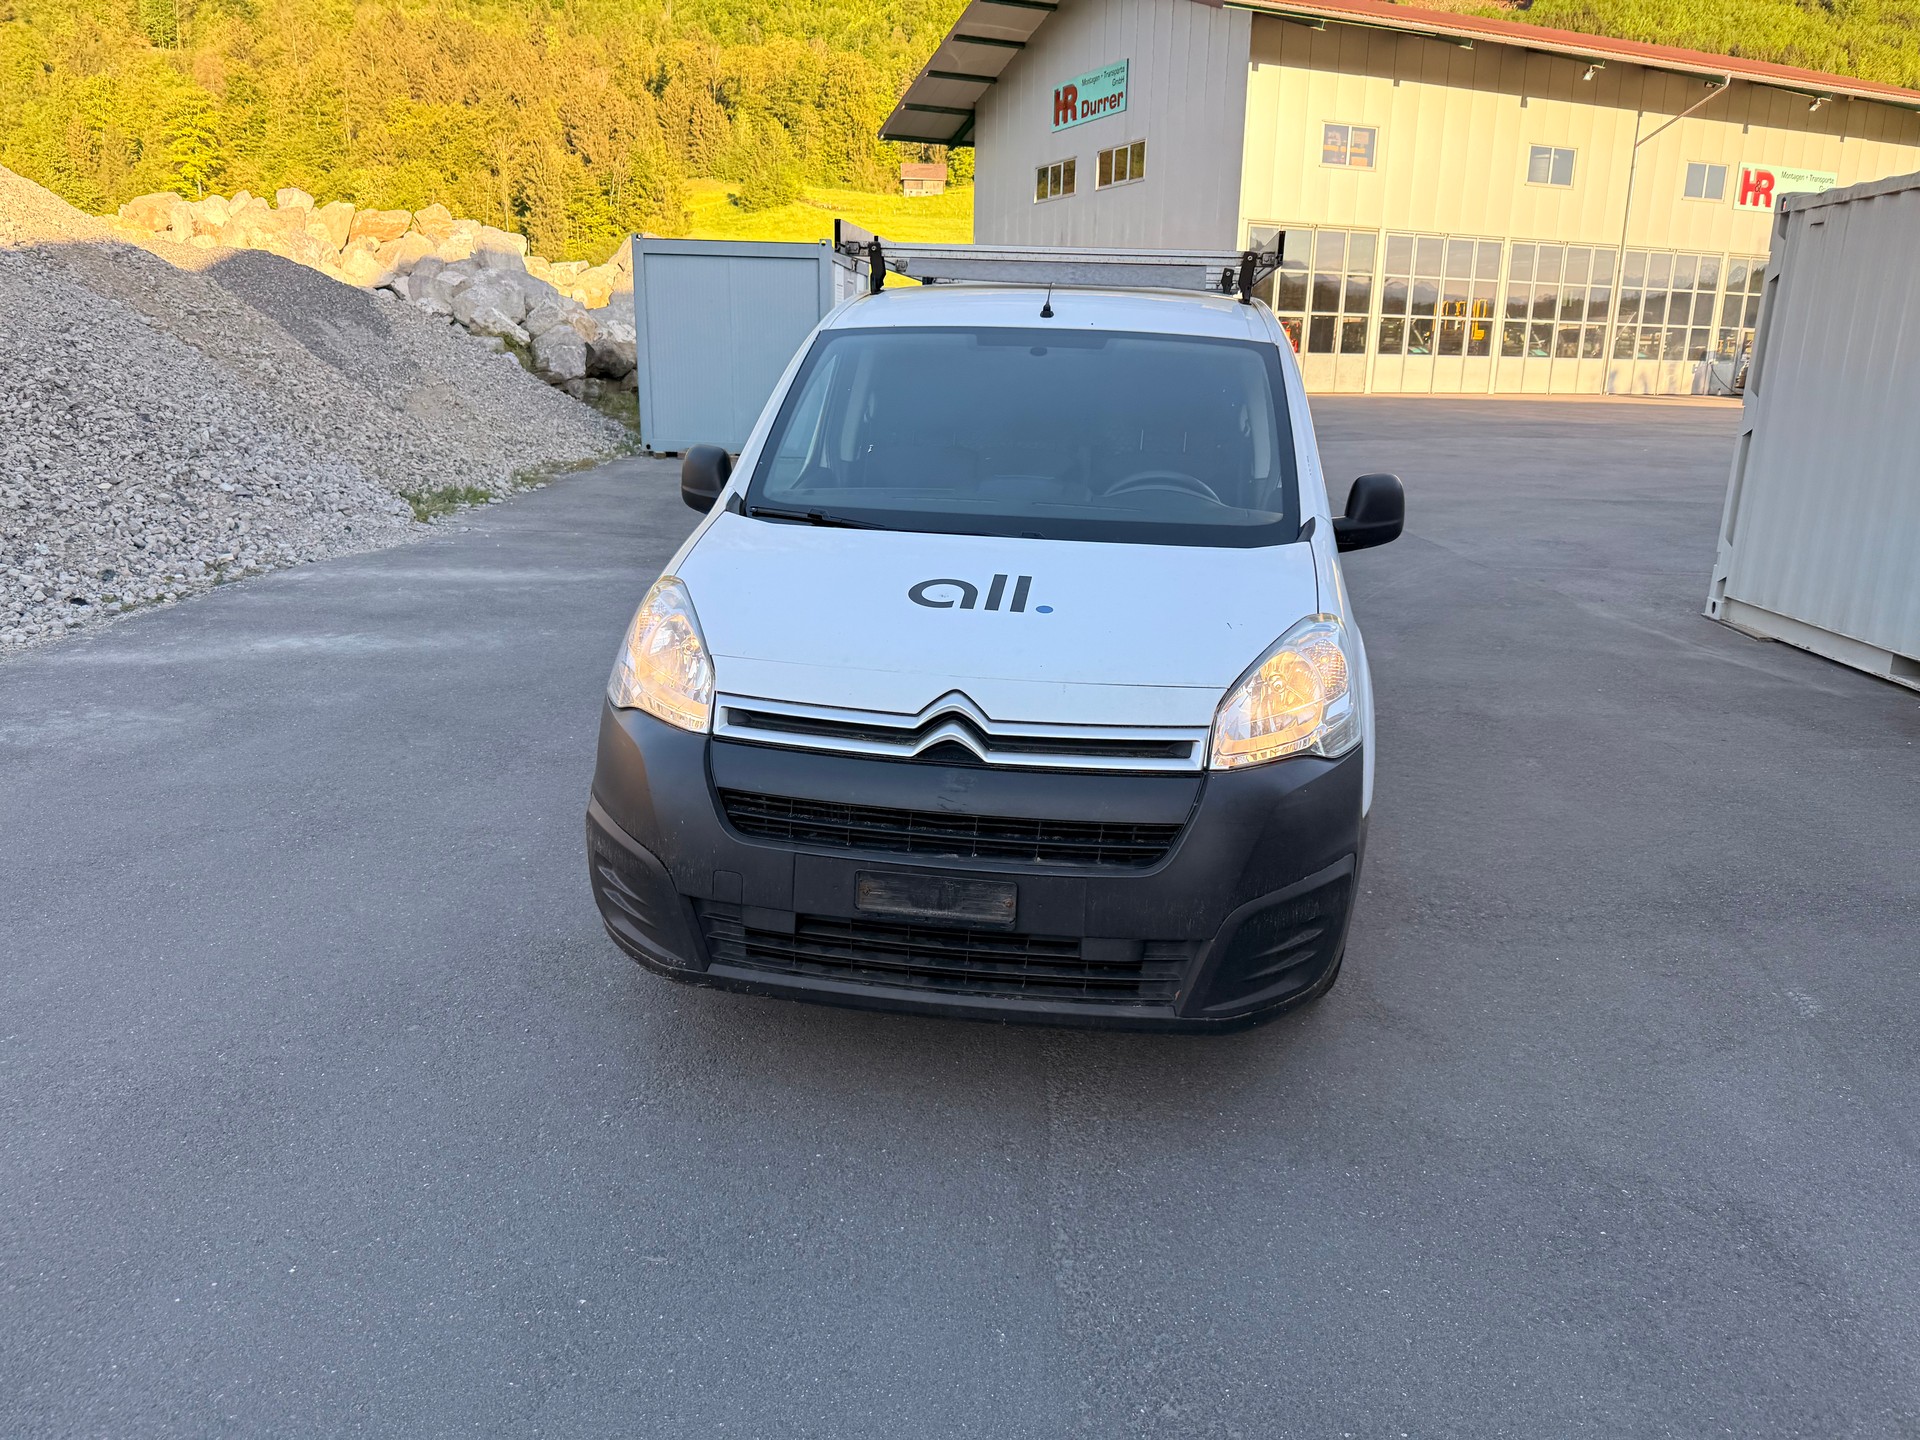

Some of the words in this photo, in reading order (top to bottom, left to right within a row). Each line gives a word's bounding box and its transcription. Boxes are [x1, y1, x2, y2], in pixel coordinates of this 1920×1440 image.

[1111, 77, 1125, 87] GmbH
[1081, 91, 1124, 119] Durrer
[1781, 171, 1805, 183] Montagen
